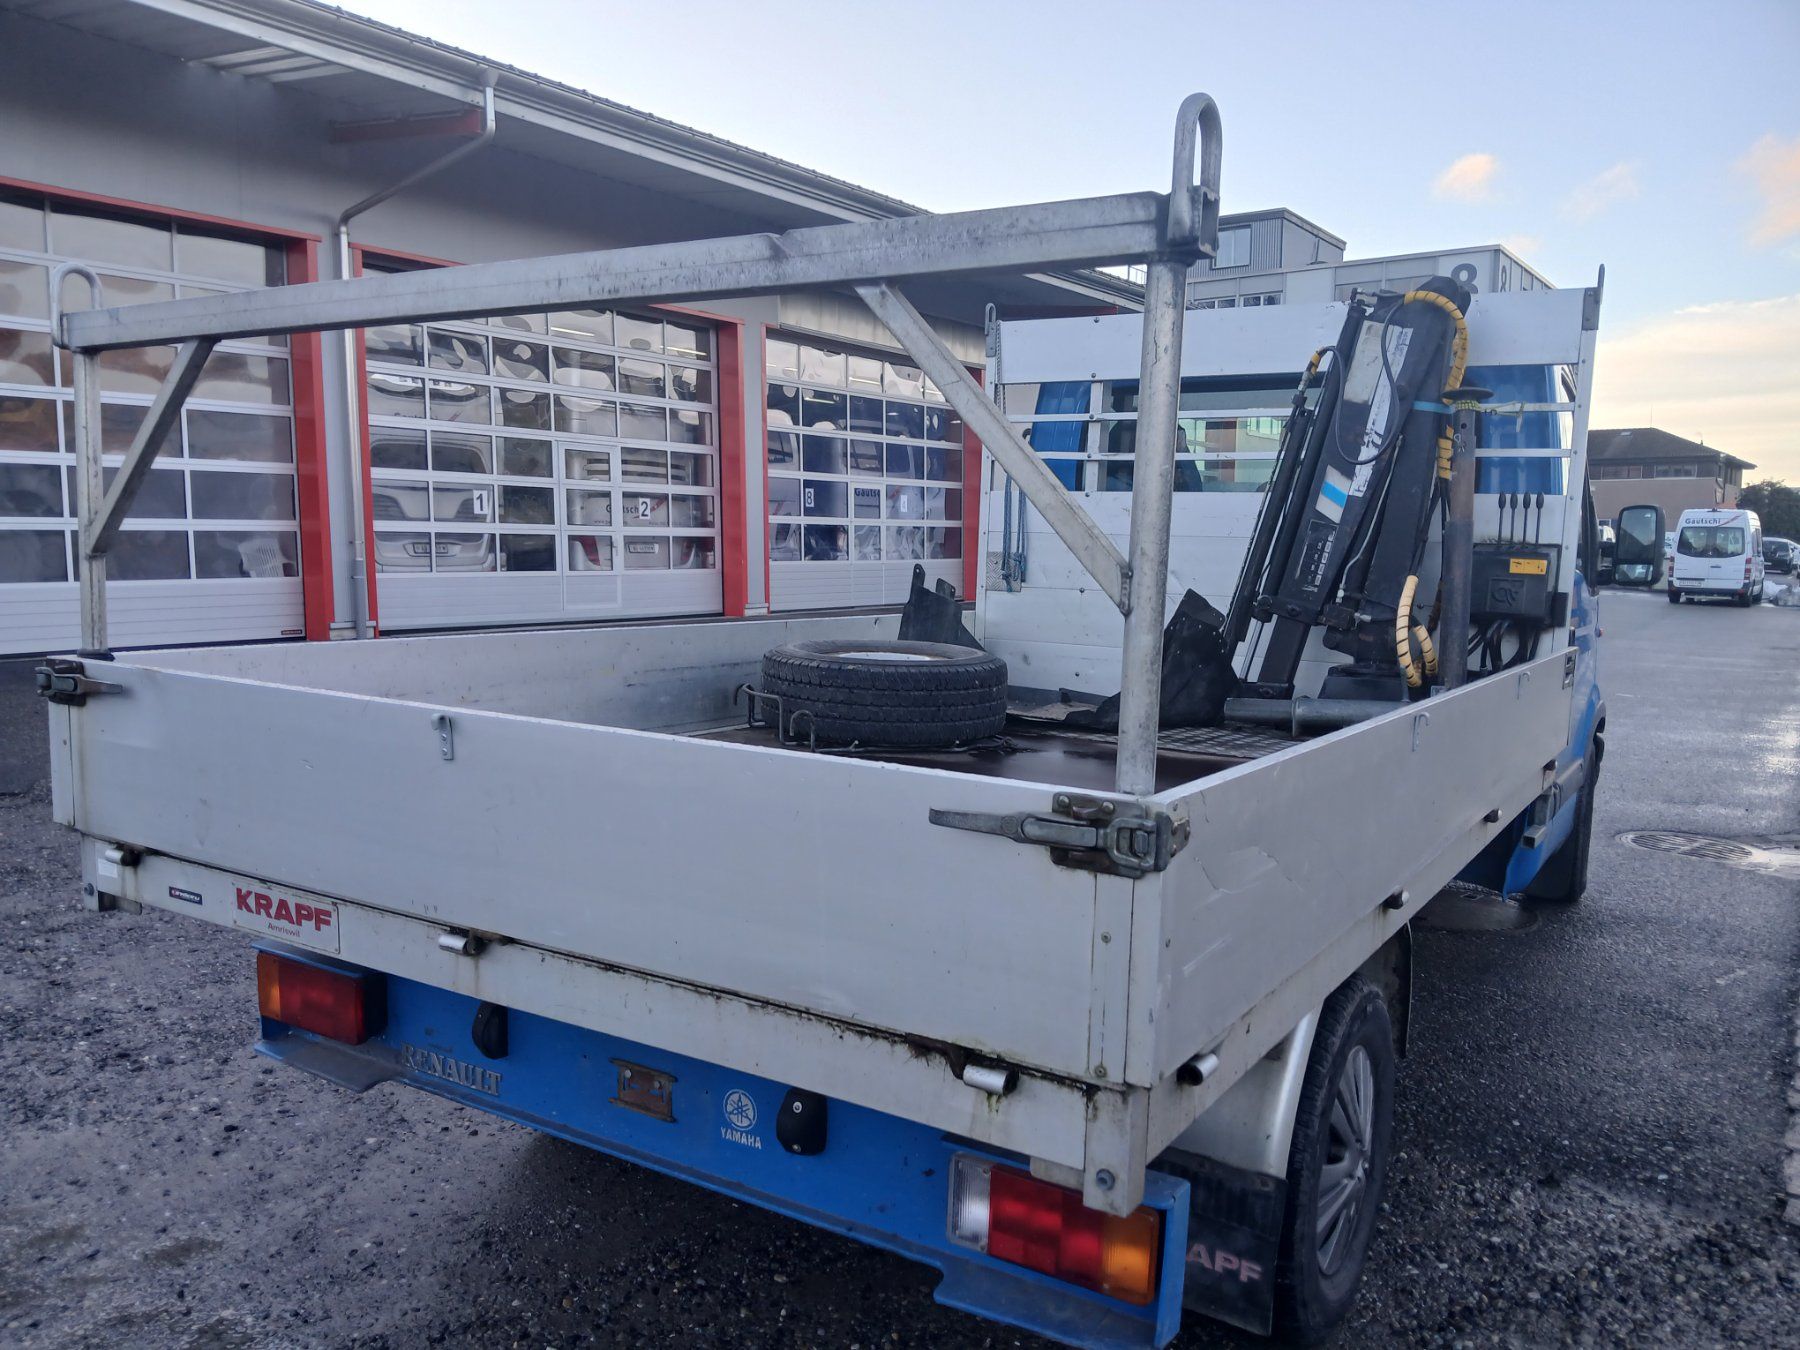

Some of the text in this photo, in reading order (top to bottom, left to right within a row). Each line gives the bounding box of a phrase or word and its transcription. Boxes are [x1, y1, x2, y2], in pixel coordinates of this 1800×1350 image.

[475, 493, 484, 512] 1
[806, 490, 813, 505] 8
[640, 500, 649, 517] 2
[1685, 517, 1720, 525] Gautschi
[236, 887, 332, 932] KRAPF
[401, 1043, 502, 1096] RENAULT
[720, 1126, 761, 1150] YAMAHA
[1185, 1243, 1262, 1283] APF
